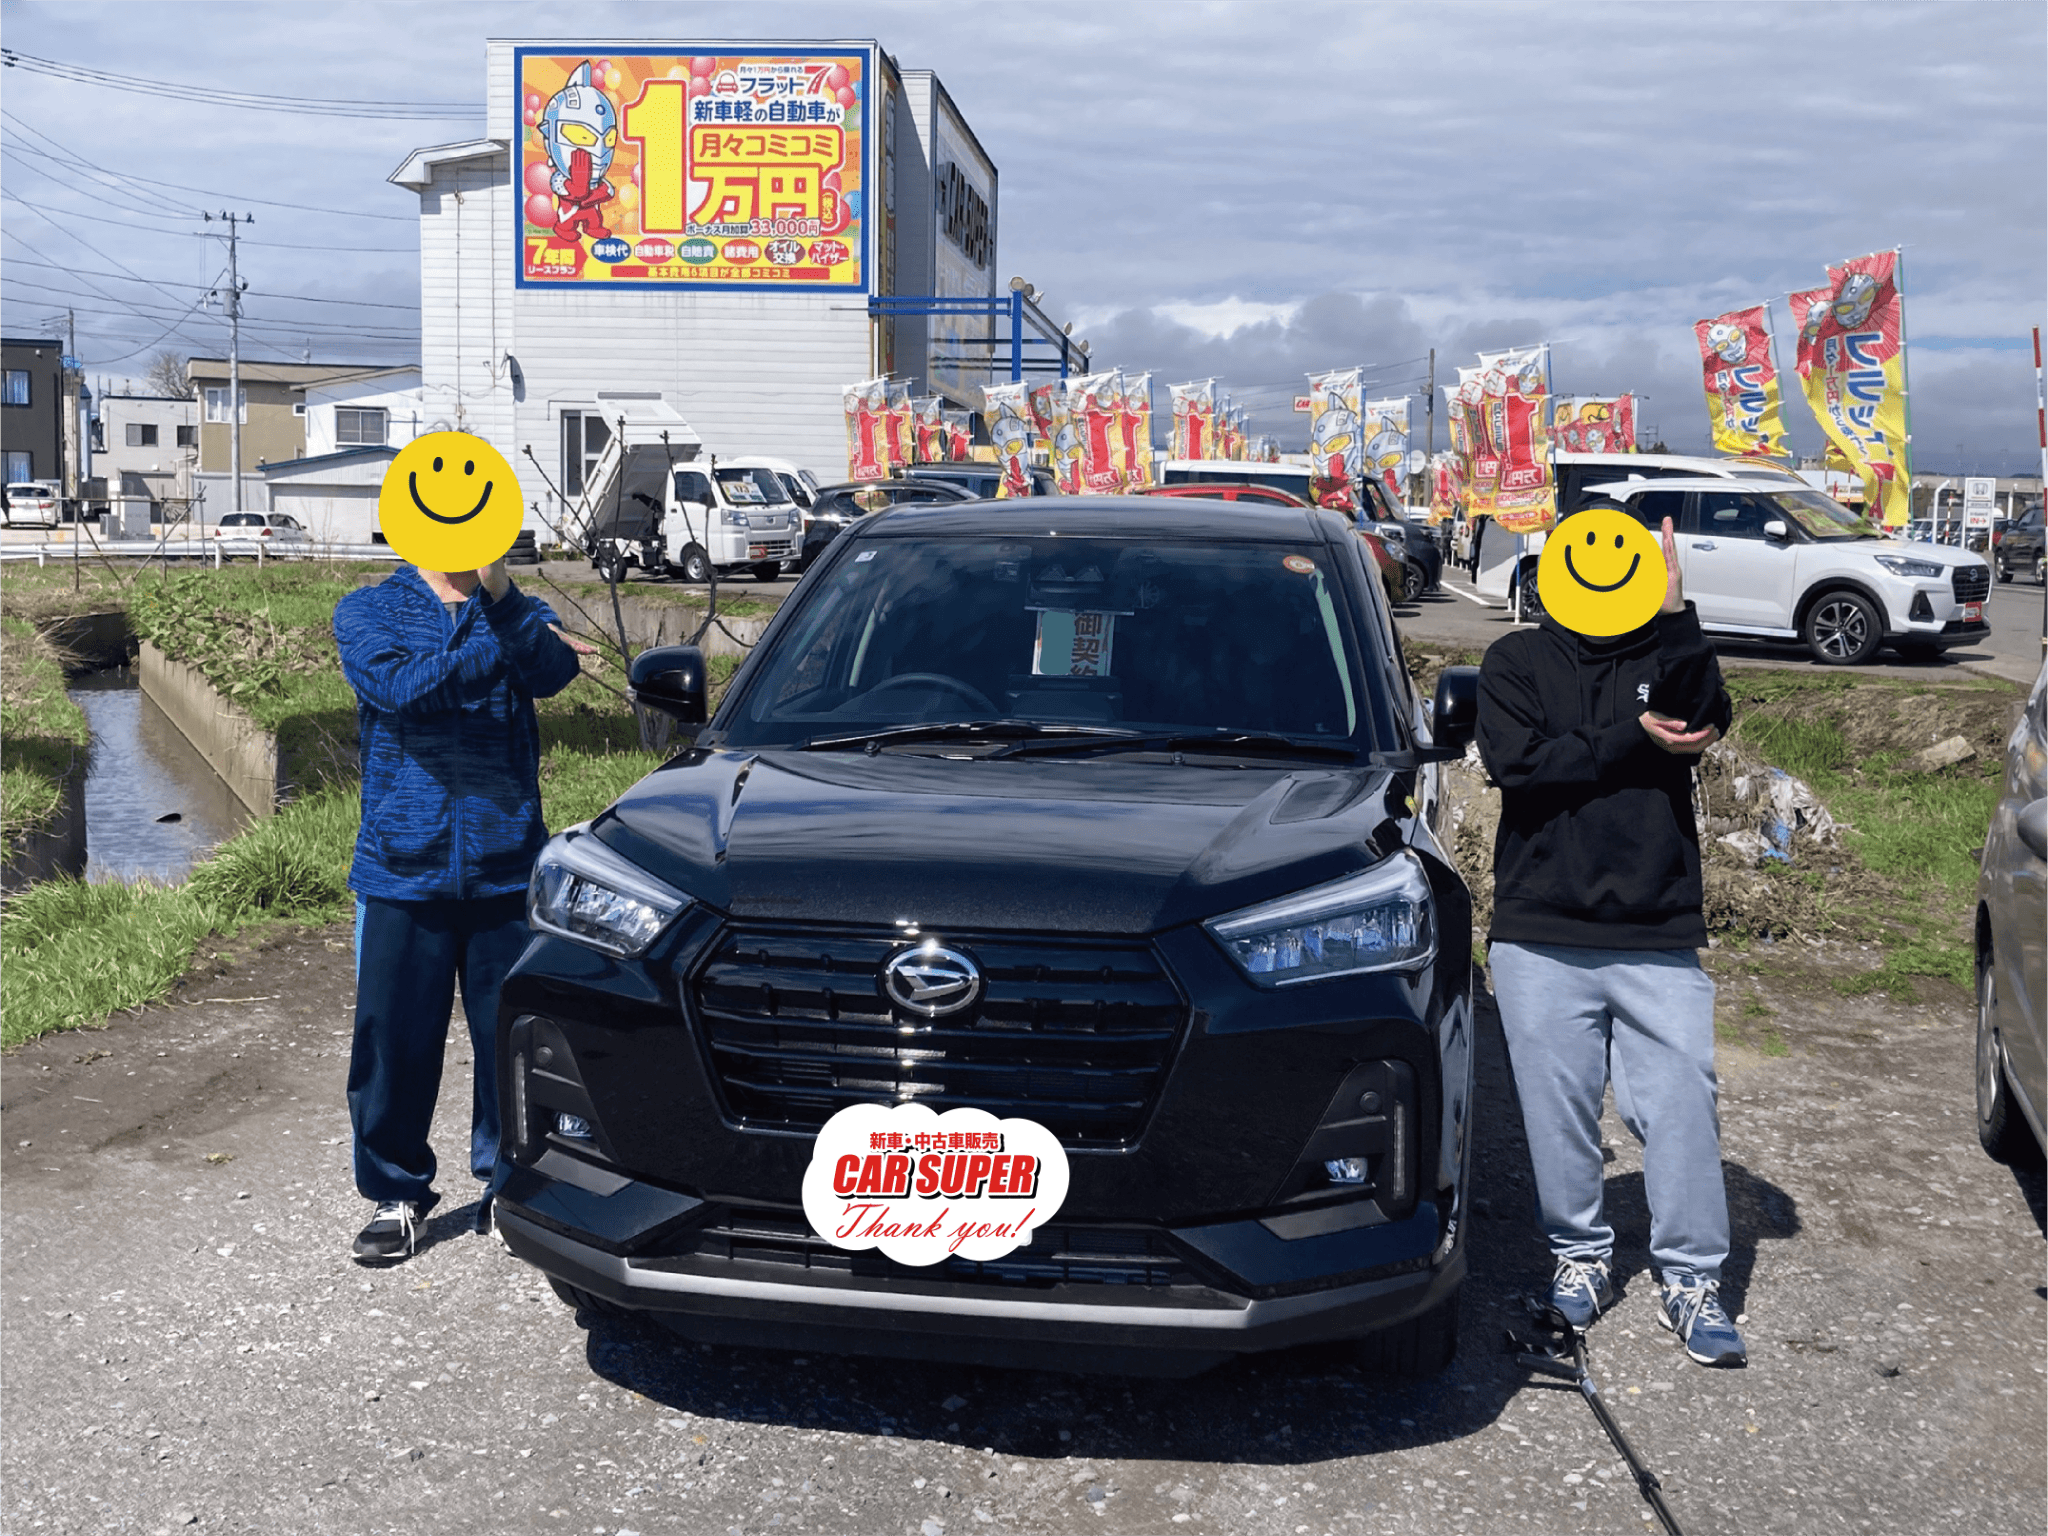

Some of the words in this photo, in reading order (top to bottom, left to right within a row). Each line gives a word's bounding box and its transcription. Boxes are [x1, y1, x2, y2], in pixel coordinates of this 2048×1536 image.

[694, 100, 840, 122] 新車軽の自動車が
[700, 133, 833, 157] 月々コミコミ
